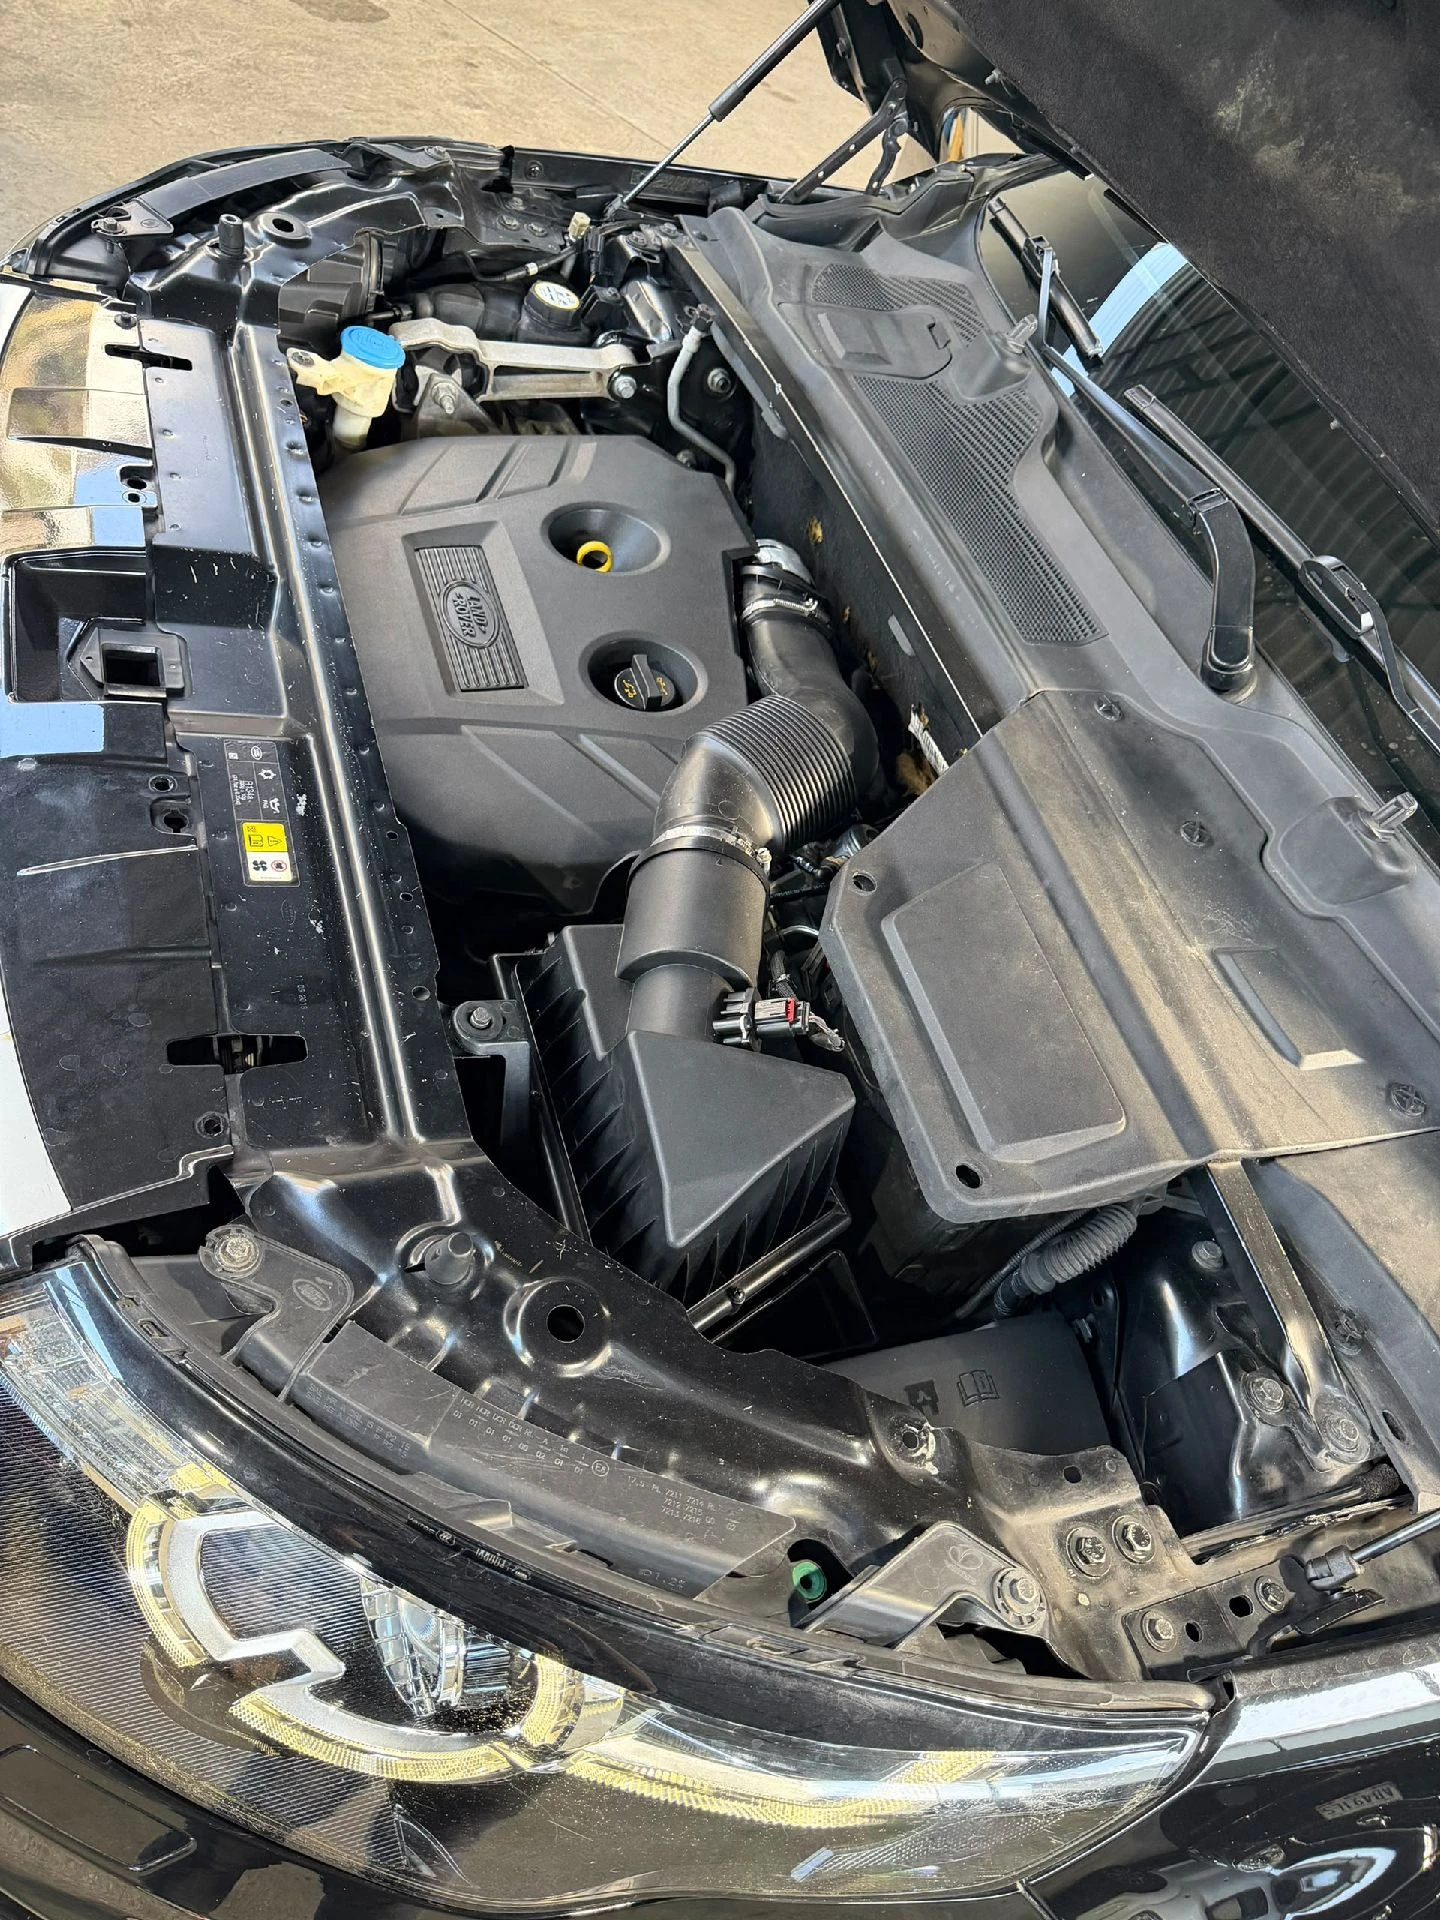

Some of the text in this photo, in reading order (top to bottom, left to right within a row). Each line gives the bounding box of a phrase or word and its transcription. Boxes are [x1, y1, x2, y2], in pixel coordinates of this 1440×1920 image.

[452, 592, 476, 638] ROVER
[466, 595, 488, 634] LAND
[535, 1450, 545, 1459] 02
